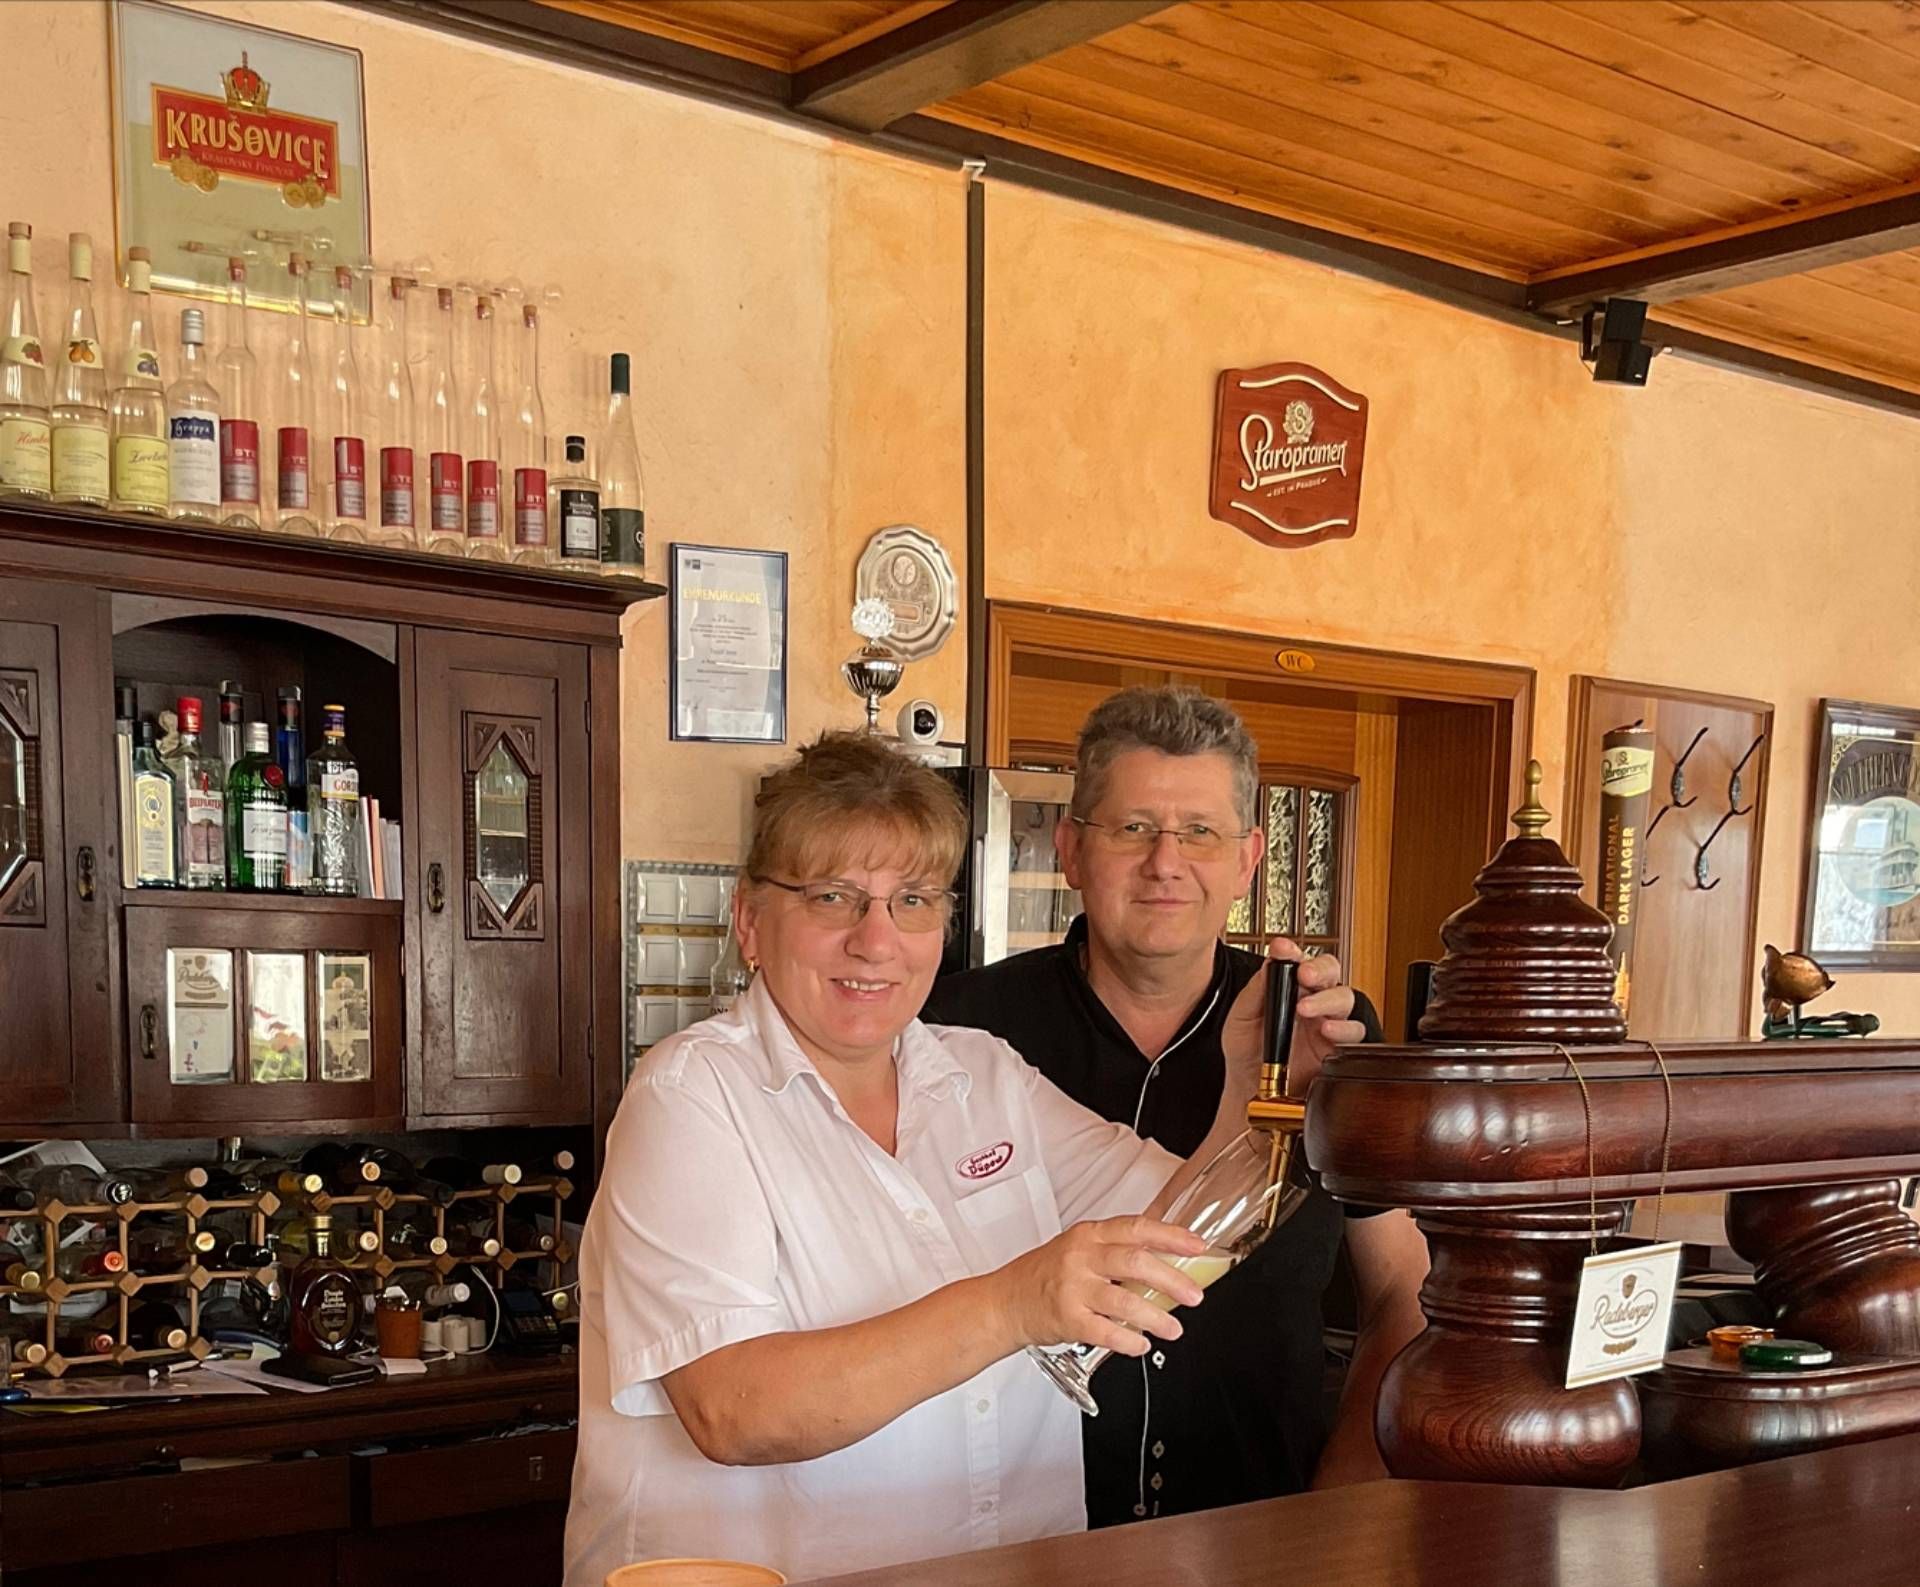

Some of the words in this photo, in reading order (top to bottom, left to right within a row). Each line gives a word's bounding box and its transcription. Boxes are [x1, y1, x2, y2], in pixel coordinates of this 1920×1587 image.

[165, 108, 329, 180] KRUŠOVICE
[175, 420, 211, 438] Grappa
[1239, 414, 1349, 492] Staropramen
[1620, 826, 1635, 879] LAGER
[1618, 883, 1632, 925] DARK
